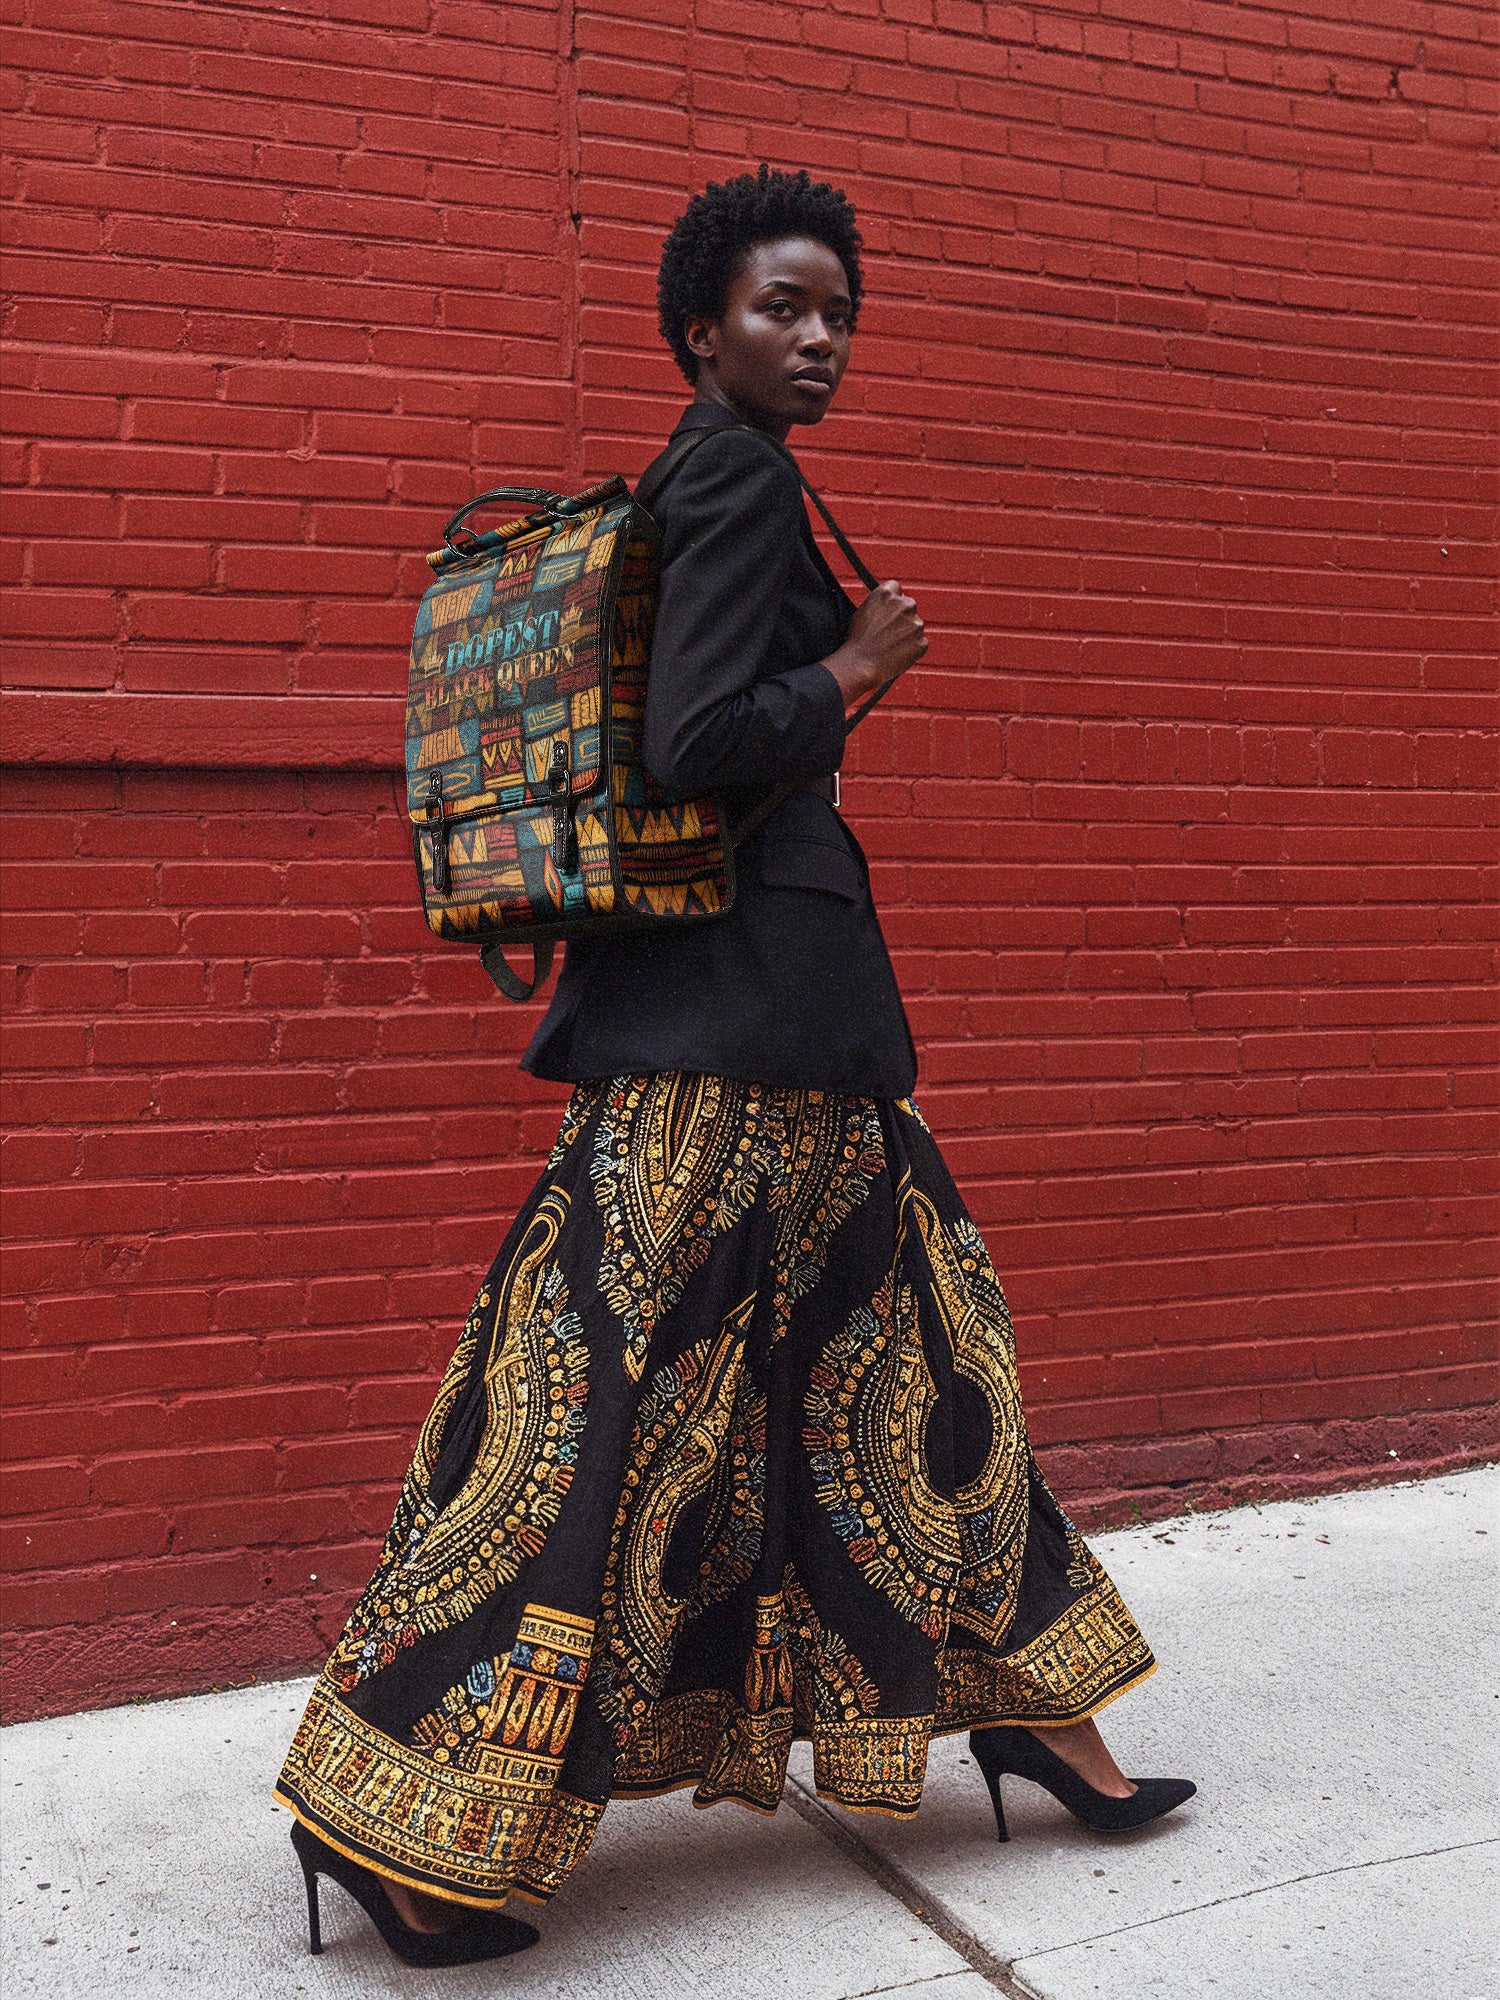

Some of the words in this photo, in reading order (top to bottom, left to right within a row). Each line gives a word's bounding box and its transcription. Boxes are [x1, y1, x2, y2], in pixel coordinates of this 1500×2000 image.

[425, 665, 494, 711] BLACK
[497, 641, 577, 690] QUEEN
[445, 610, 559, 676] DOPEST
